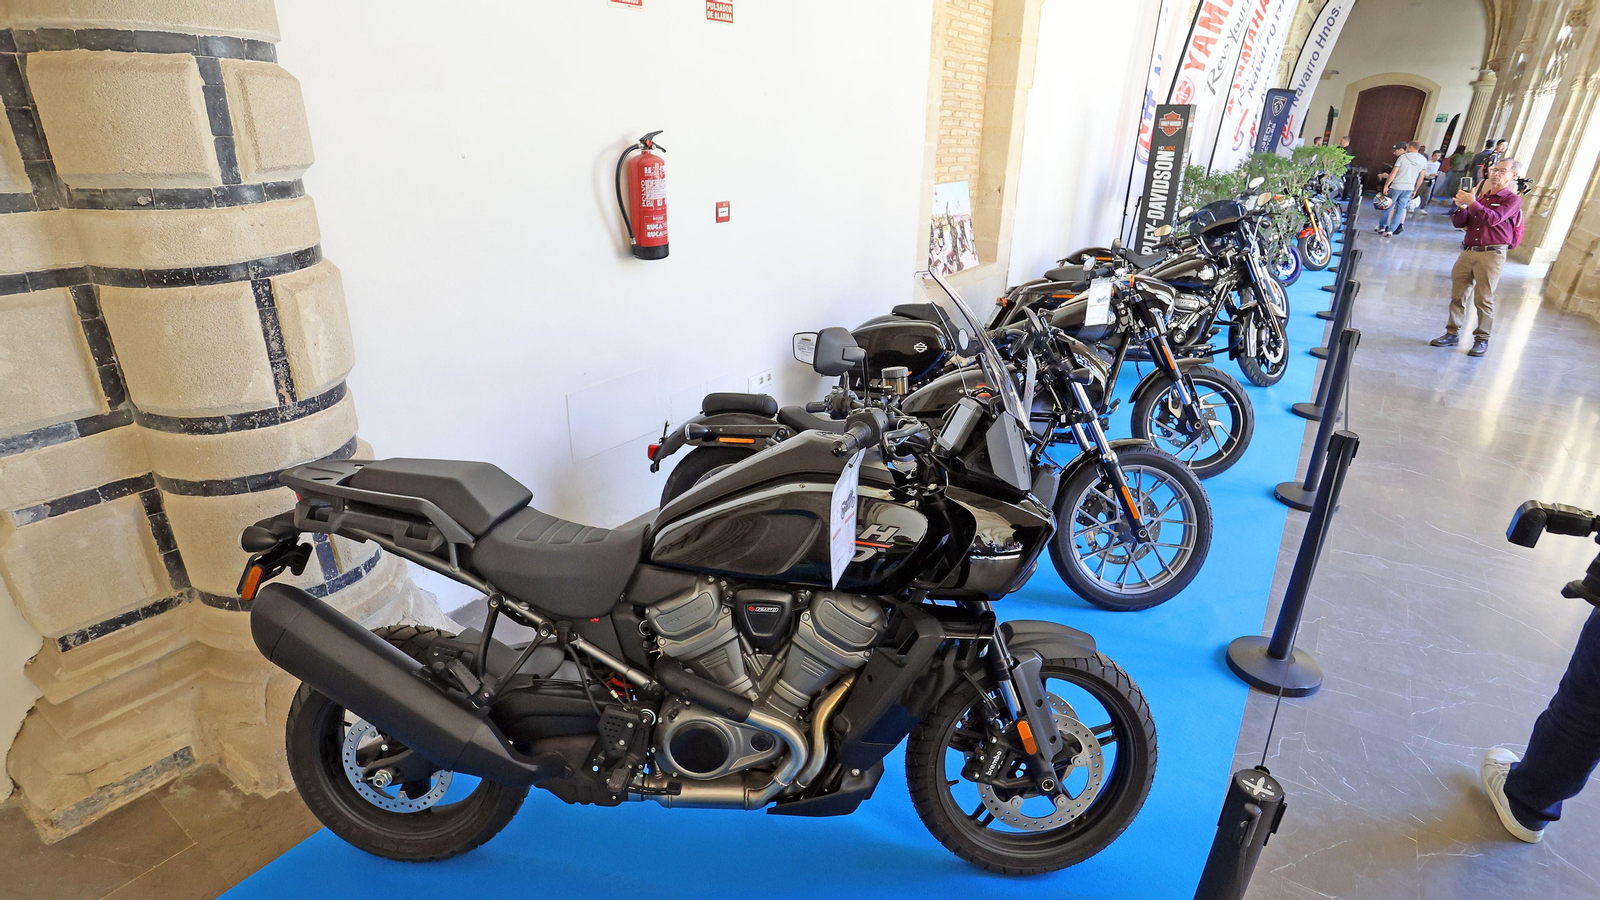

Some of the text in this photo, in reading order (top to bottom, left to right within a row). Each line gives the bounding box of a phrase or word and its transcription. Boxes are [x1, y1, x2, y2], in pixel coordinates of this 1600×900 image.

[706, 2, 732, 13] PULSADOR
[707, 10, 733, 22] DE ALARMA
[1184, 0, 1234, 72] YAM
[1204, 6, 1247, 96] Revs Your
[1292, 5, 1342, 108] Navarro Hnos.
[1261, 119, 1273, 152] GEOT
[985, 750, 1002, 776] brembo
